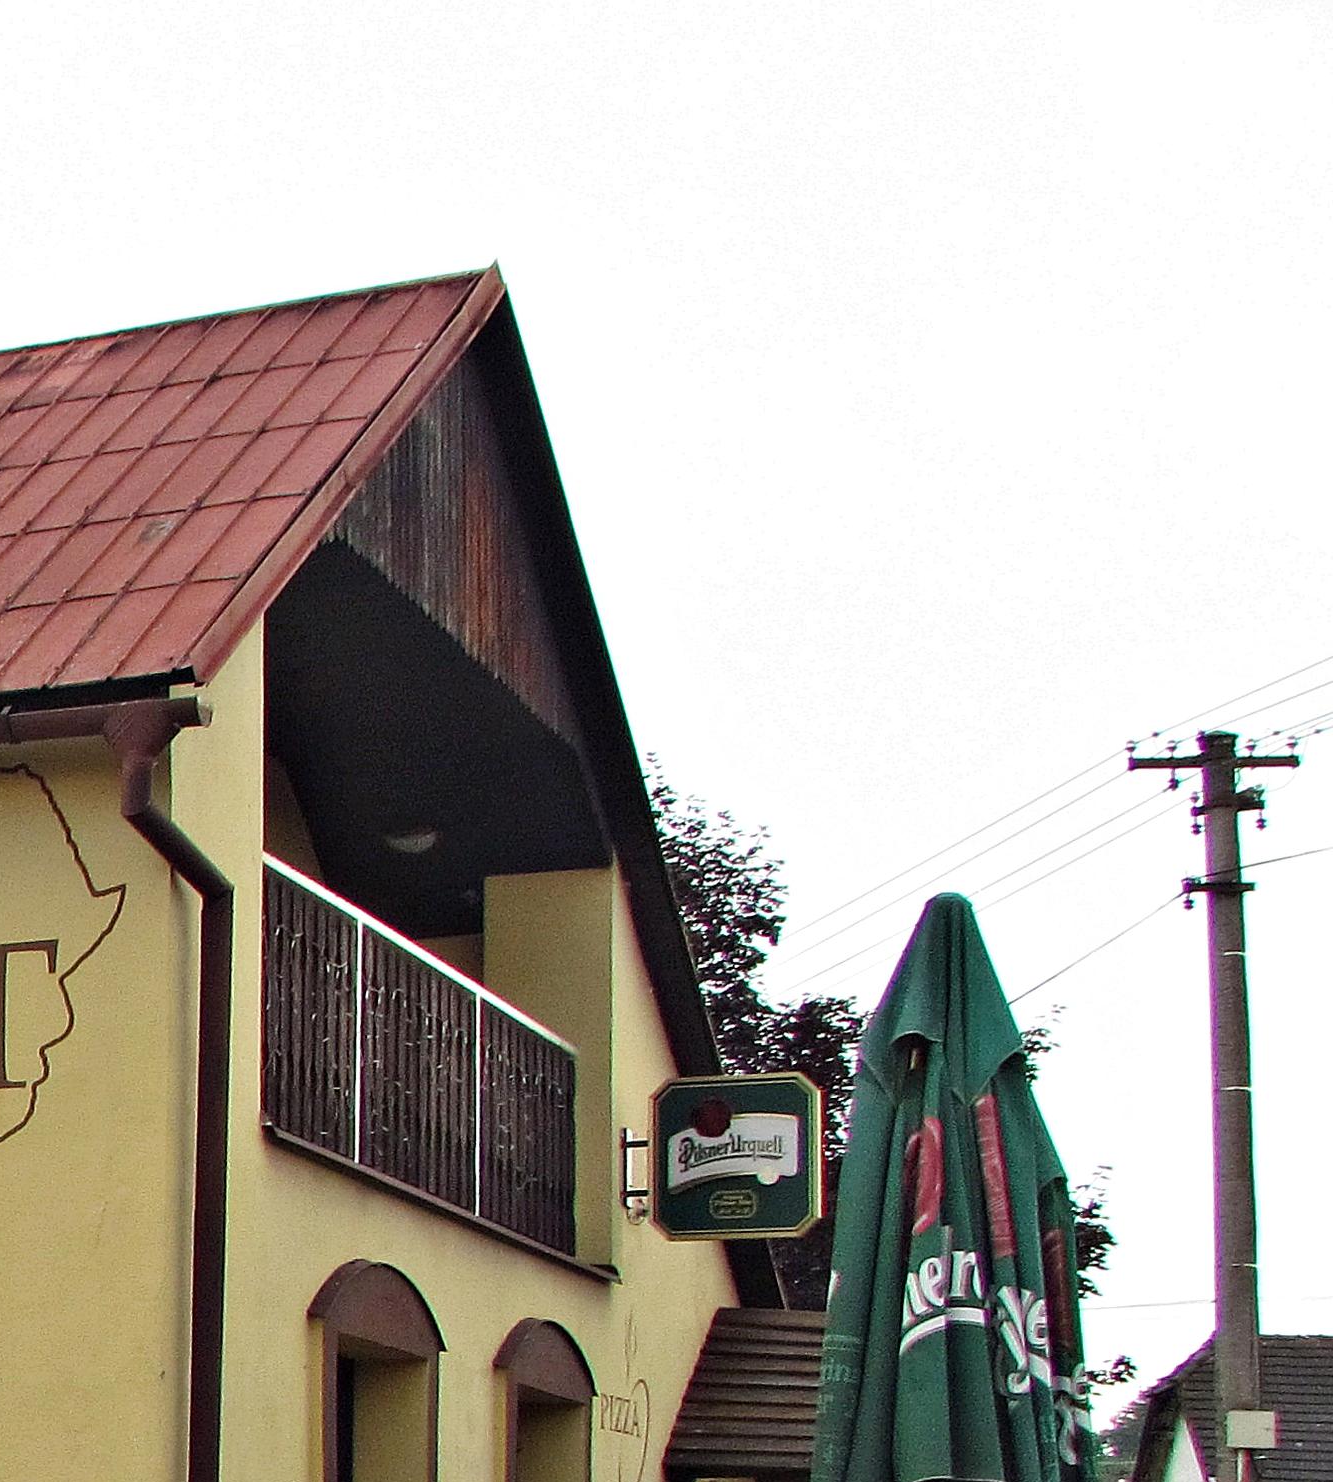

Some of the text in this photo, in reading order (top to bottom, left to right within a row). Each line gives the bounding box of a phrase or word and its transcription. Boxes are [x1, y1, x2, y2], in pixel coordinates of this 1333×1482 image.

[678, 1133, 783, 1173] Pilsner Urquell
[600, 1392, 641, 1438] PIZZA
